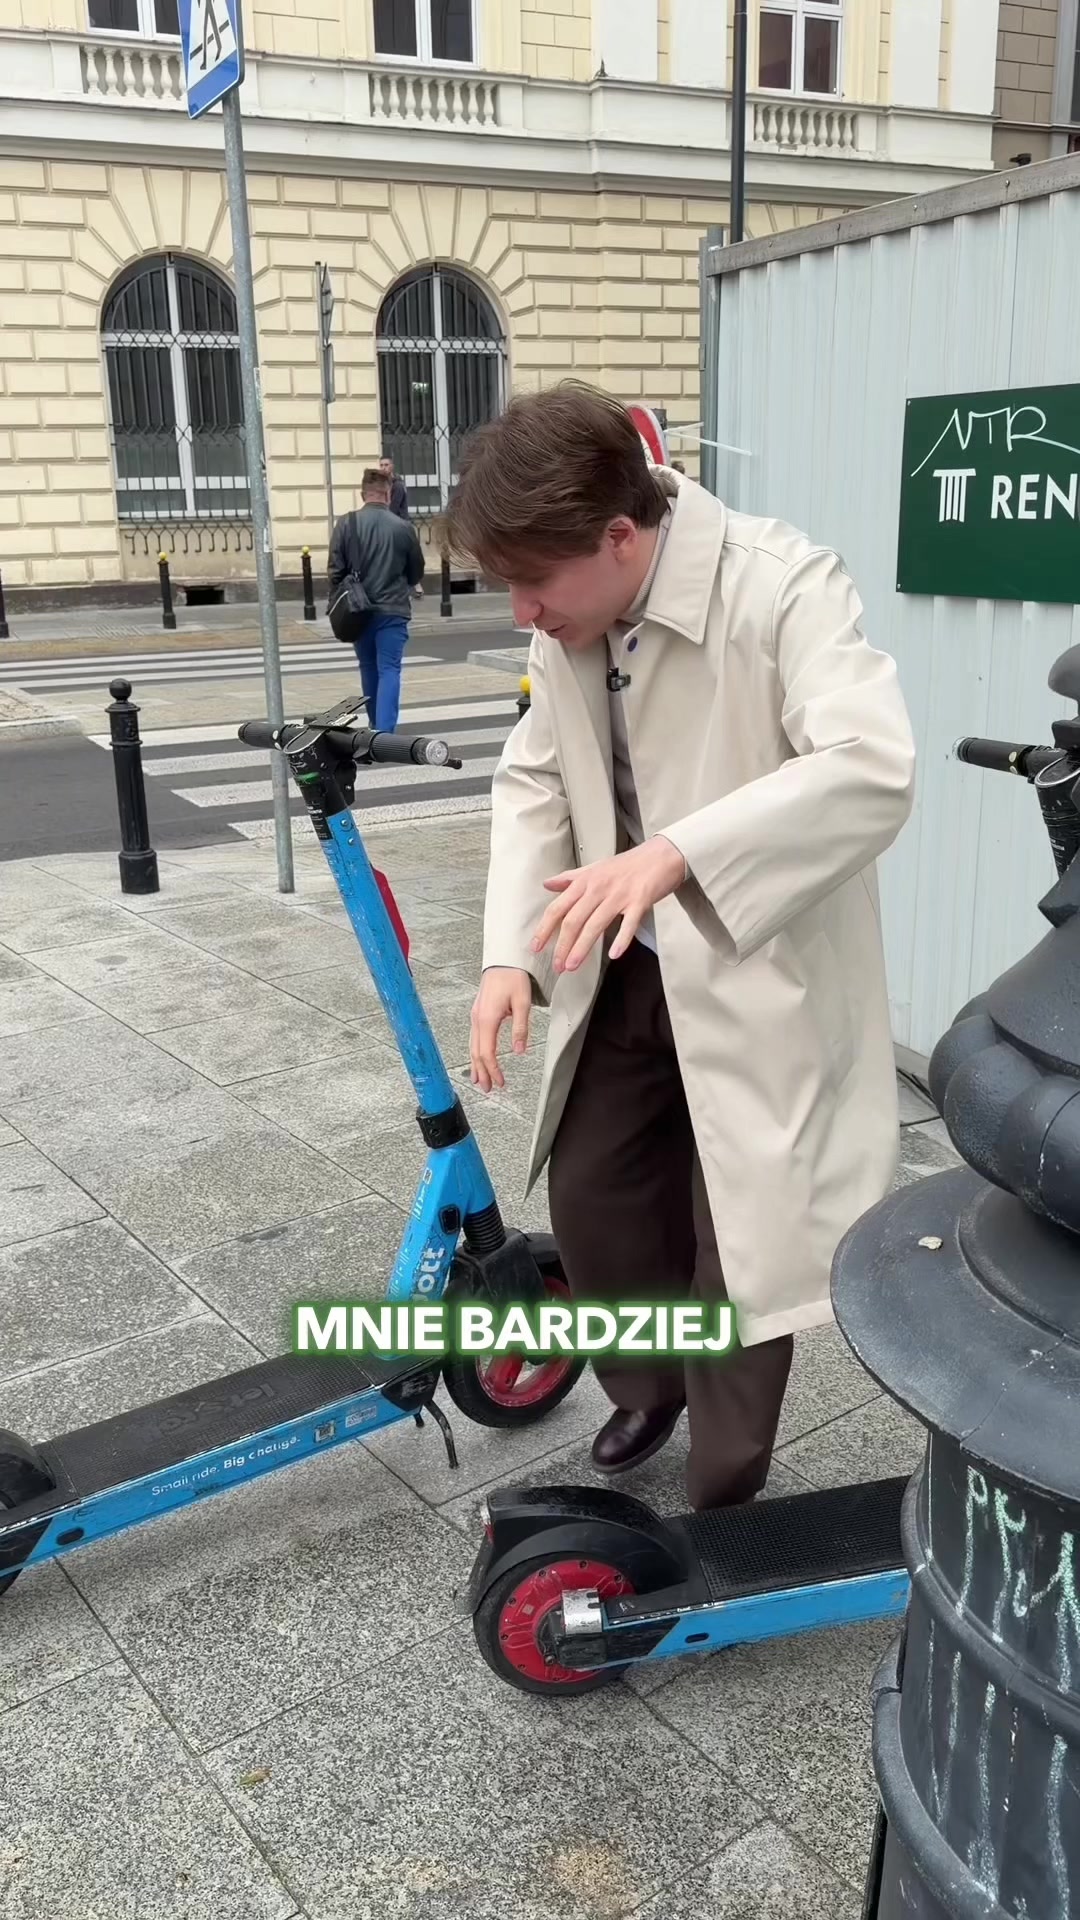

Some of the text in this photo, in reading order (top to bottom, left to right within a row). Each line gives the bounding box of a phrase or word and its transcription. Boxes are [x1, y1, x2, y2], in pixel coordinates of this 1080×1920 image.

[990, 473, 1080, 520] REN
[151, 1475, 189, 1496] Small
[192, 1465, 220, 1483] ride.
[223, 1456, 245, 1470] Big
